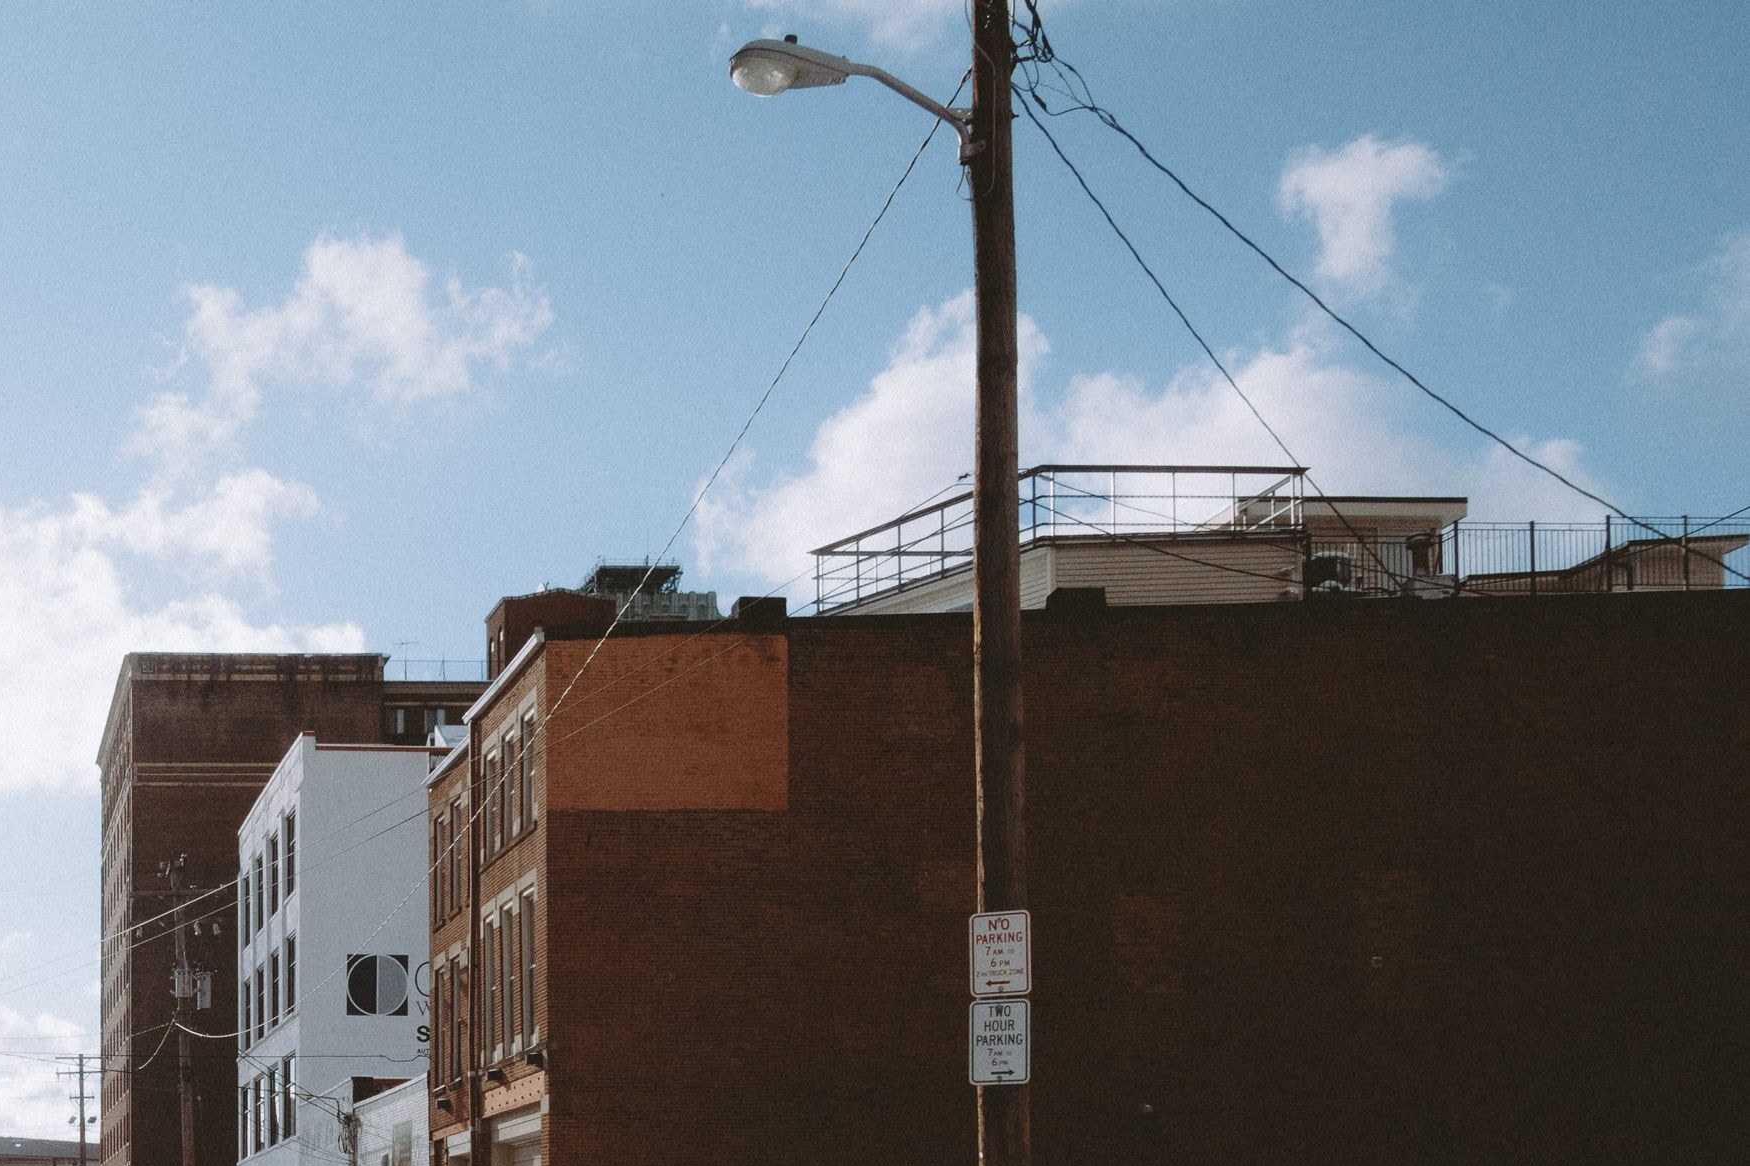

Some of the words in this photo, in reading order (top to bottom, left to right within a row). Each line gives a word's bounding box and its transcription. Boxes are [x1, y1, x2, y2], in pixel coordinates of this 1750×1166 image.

[988, 918, 1010, 931] NO
[976, 931, 1023, 944] PARKING
[985, 946, 991, 956] 7
[990, 957, 997, 968] 6
[1009, 968, 1025, 976] ZONE
[988, 1005, 1011, 1017] TWO
[984, 1019, 1015, 1032] HOUR
[976, 1033, 1023, 1046] PARKING
[987, 1048, 993, 1056] 7
[991, 1058, 998, 1066] 6
